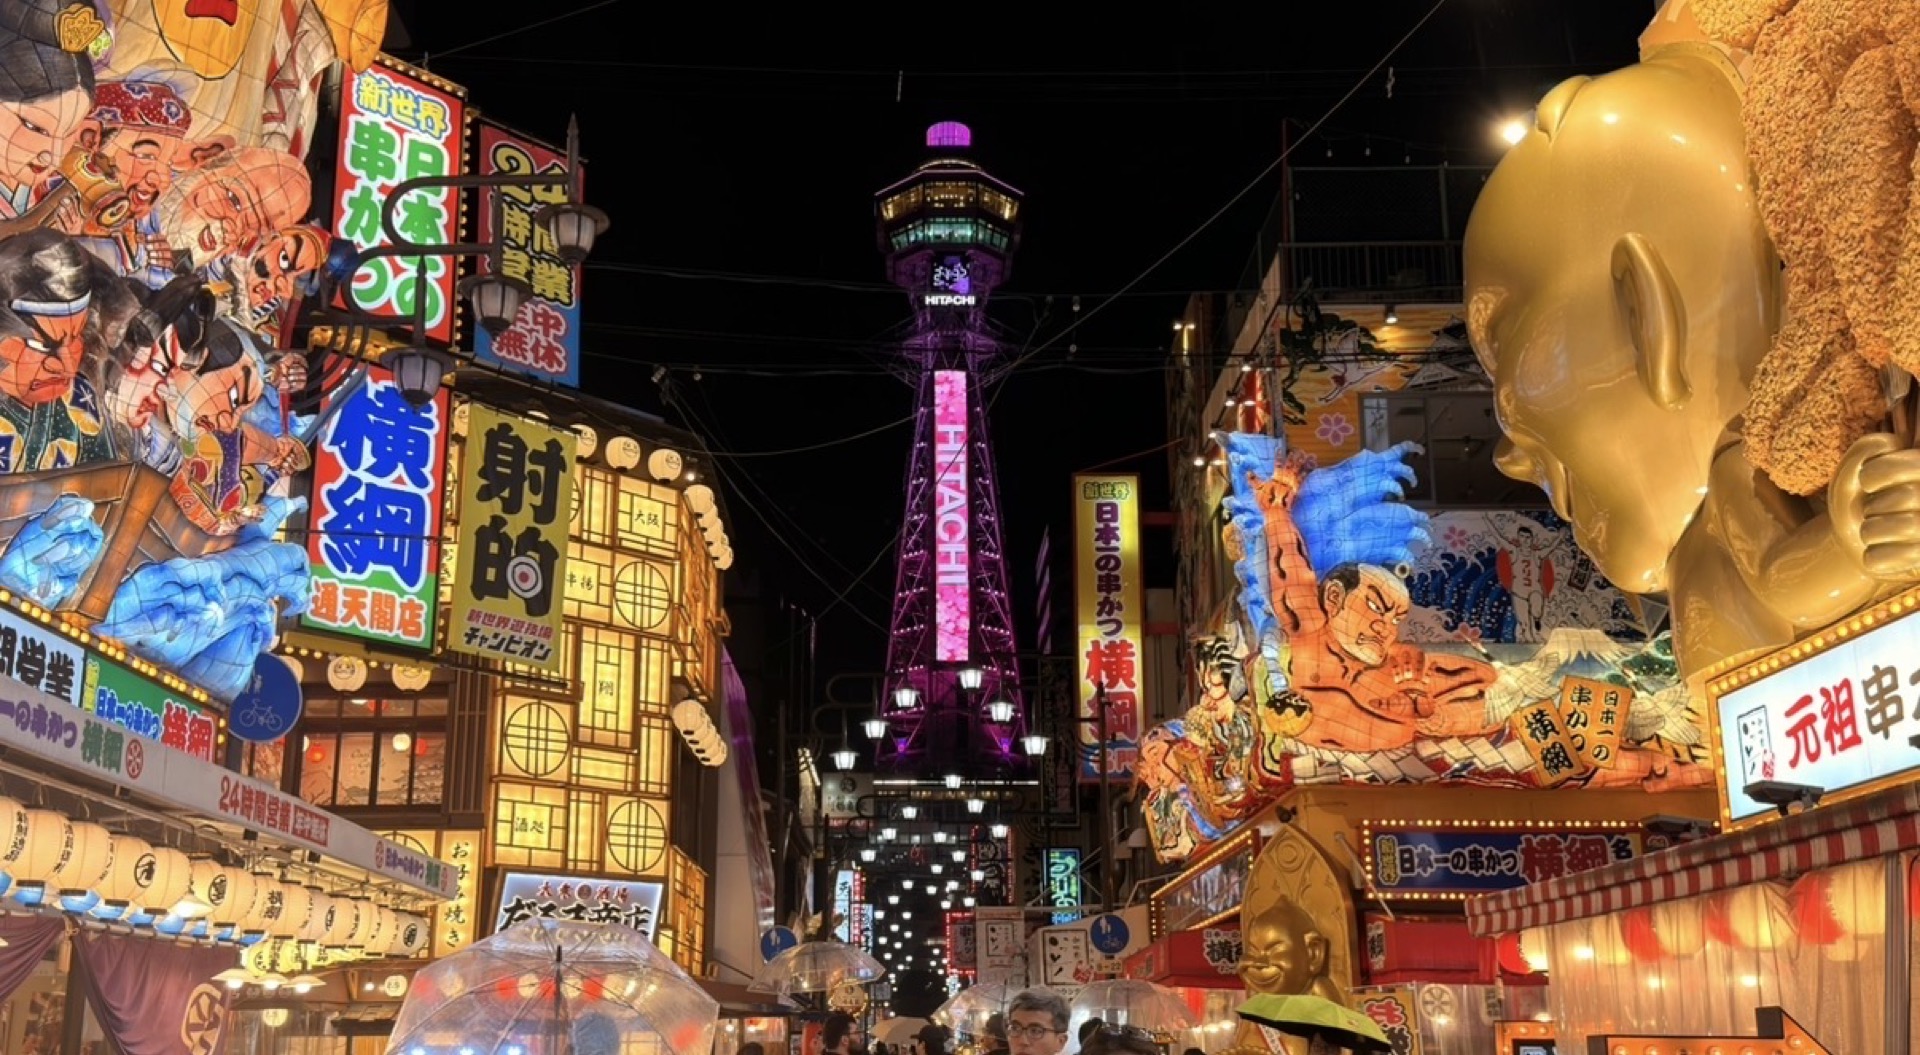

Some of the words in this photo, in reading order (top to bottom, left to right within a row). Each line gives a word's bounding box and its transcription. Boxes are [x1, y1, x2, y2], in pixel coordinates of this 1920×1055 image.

[357, 73, 448, 138] 新世界
[344, 120, 396, 303] 串かつ
[397, 139, 446, 323] 日本一の
[502, 203, 559, 252] 時
[925, 295, 975, 305] HITACHI
[494, 330, 564, 371] 無休
[323, 384, 435, 590] 横綱
[470, 423, 568, 617] 射的
[634, 508, 660, 528] 大阪
[936, 424, 968, 586] HITACHI
[1094, 502, 1124, 638] 日本一の串かつ
[308, 580, 426, 638] 通天閣店
[463, 626, 552, 661] チャンピオン
[1086, 640, 1139, 743] 横綱
[1566, 684, 1594, 752] 串かつ
[1592, 690, 1620, 762] 日本一の
[218, 775, 292, 833] 24時間営業
[1398, 845, 1517, 875] 日本一の串かつ
[1521, 836, 1609, 883] 横綱
